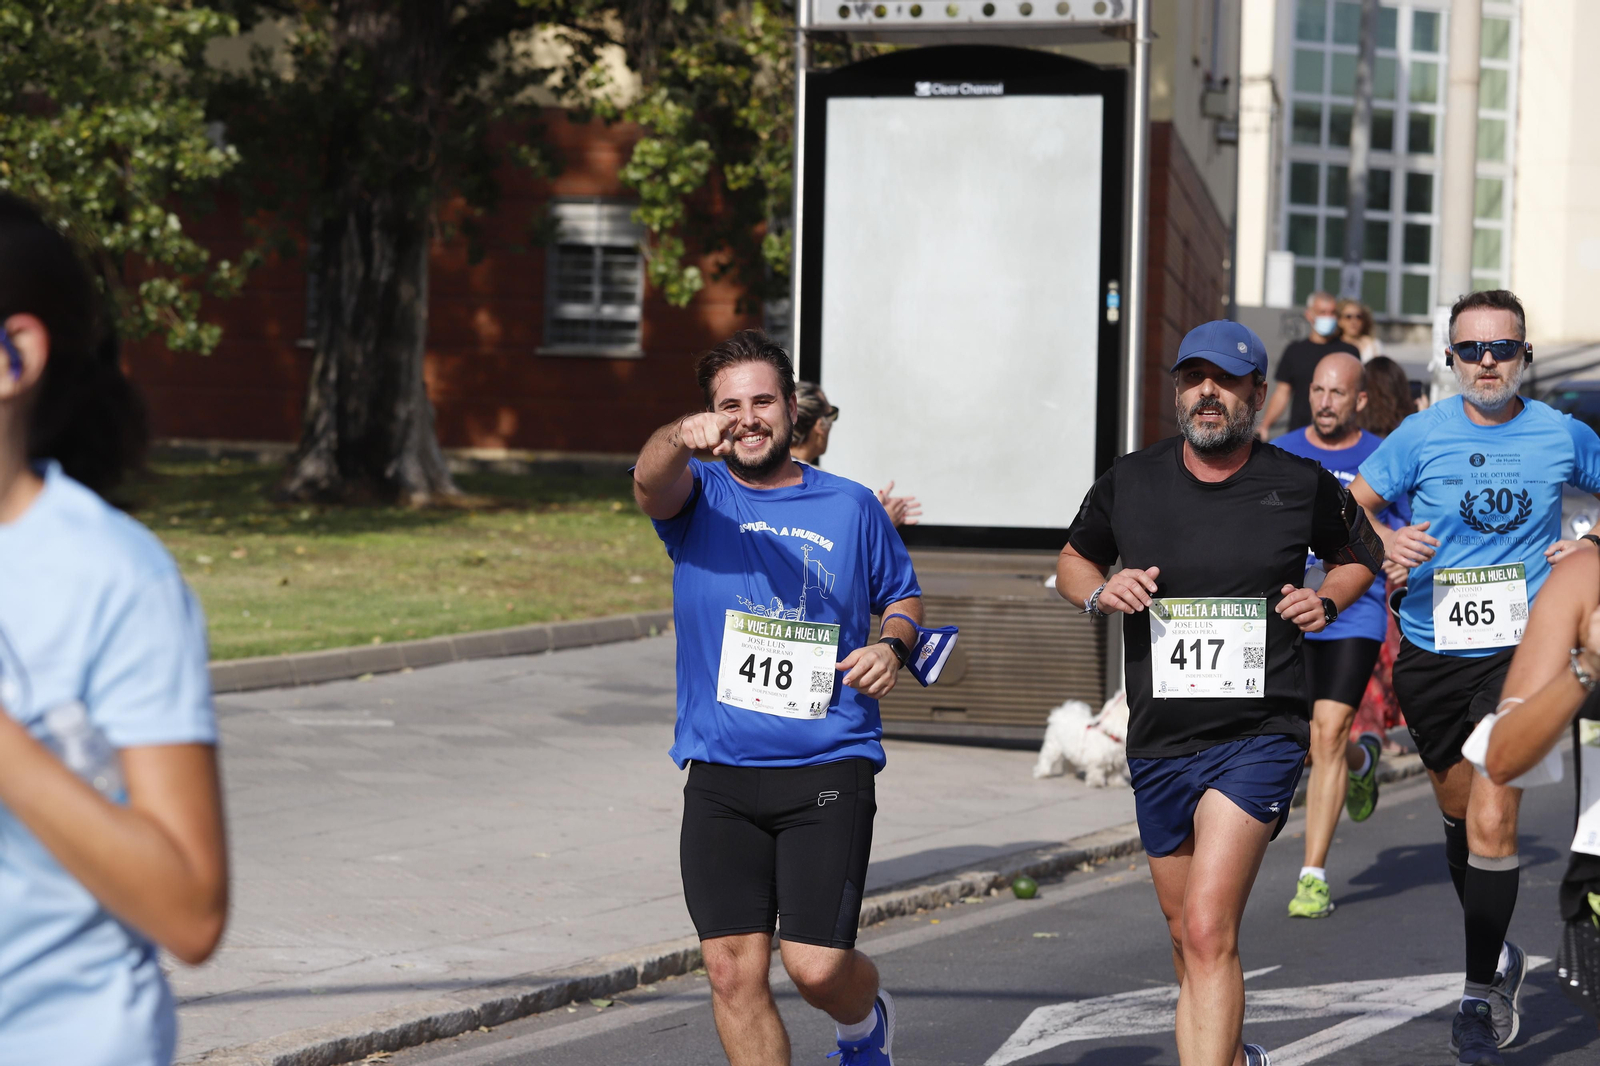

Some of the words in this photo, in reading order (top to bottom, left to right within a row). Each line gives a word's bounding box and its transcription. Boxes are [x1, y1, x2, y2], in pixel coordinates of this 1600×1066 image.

[931, 82, 959, 95] Clear
[960, 82, 1004, 95] Channel
[1479, 488, 1513, 514] 30
[780, 527, 789, 536] A
[791, 528, 834, 552] HUELVA
[1448, 572, 1477, 584] VUELTA
[1480, 571, 1486, 583] A
[1488, 568, 1518, 581] HUELVA
[1159, 604, 1169, 617] 34
[1172, 604, 1207, 617] VUELTA
[1211, 604, 1218, 616] A
[1221, 604, 1258, 617] HUELVA
[1449, 600, 1495, 626] 465
[733, 616, 744, 630] 34
[747, 619, 782, 638] VUELTA
[785, 626, 792, 638] A
[794, 626, 830, 642] HUELVA
[747, 636, 765, 646] JOSE
[767, 640, 785, 649] LUIS
[766, 648, 793, 656] SERRANO
[1170, 638, 1225, 670] 417
[739, 653, 793, 690] 418
